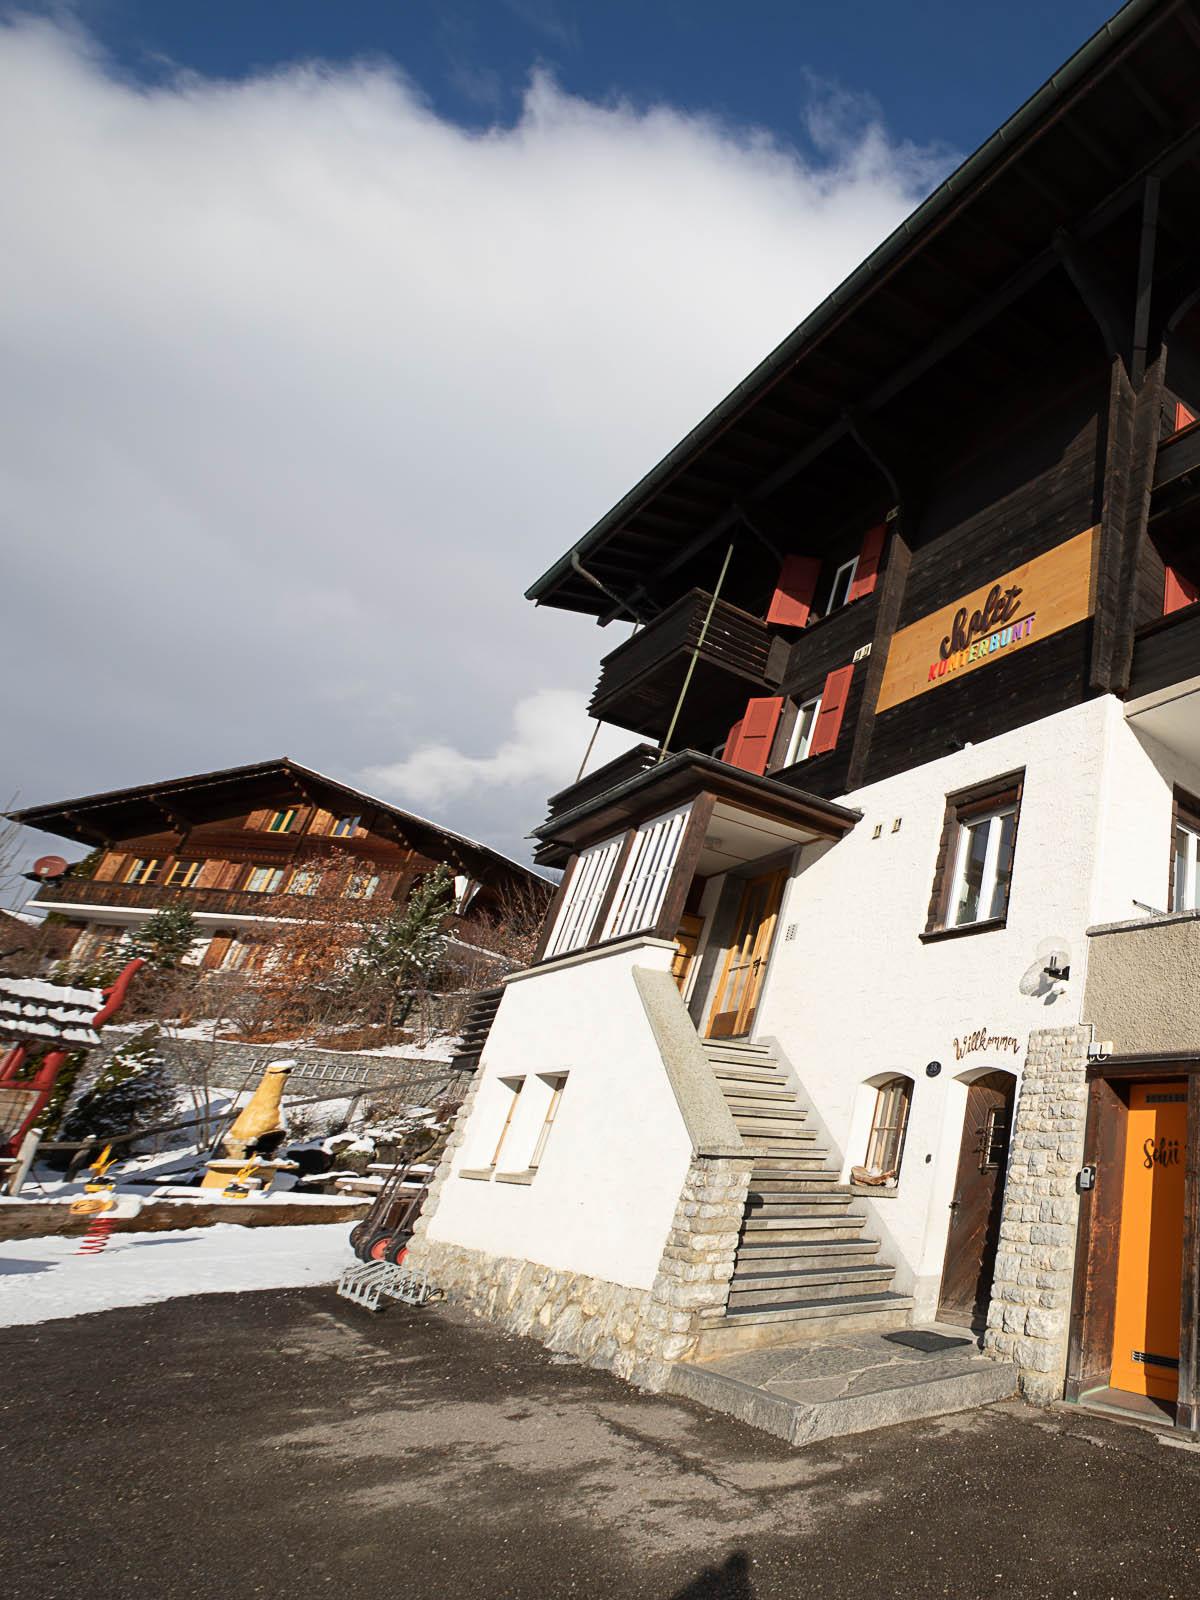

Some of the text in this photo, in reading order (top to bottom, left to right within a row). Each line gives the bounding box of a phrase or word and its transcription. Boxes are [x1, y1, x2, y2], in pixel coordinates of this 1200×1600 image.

[927, 615, 1036, 682] KUNTERBUNT
[940, 584, 1023, 660] chalet
[952, 1027, 1020, 1061] Willkommen
